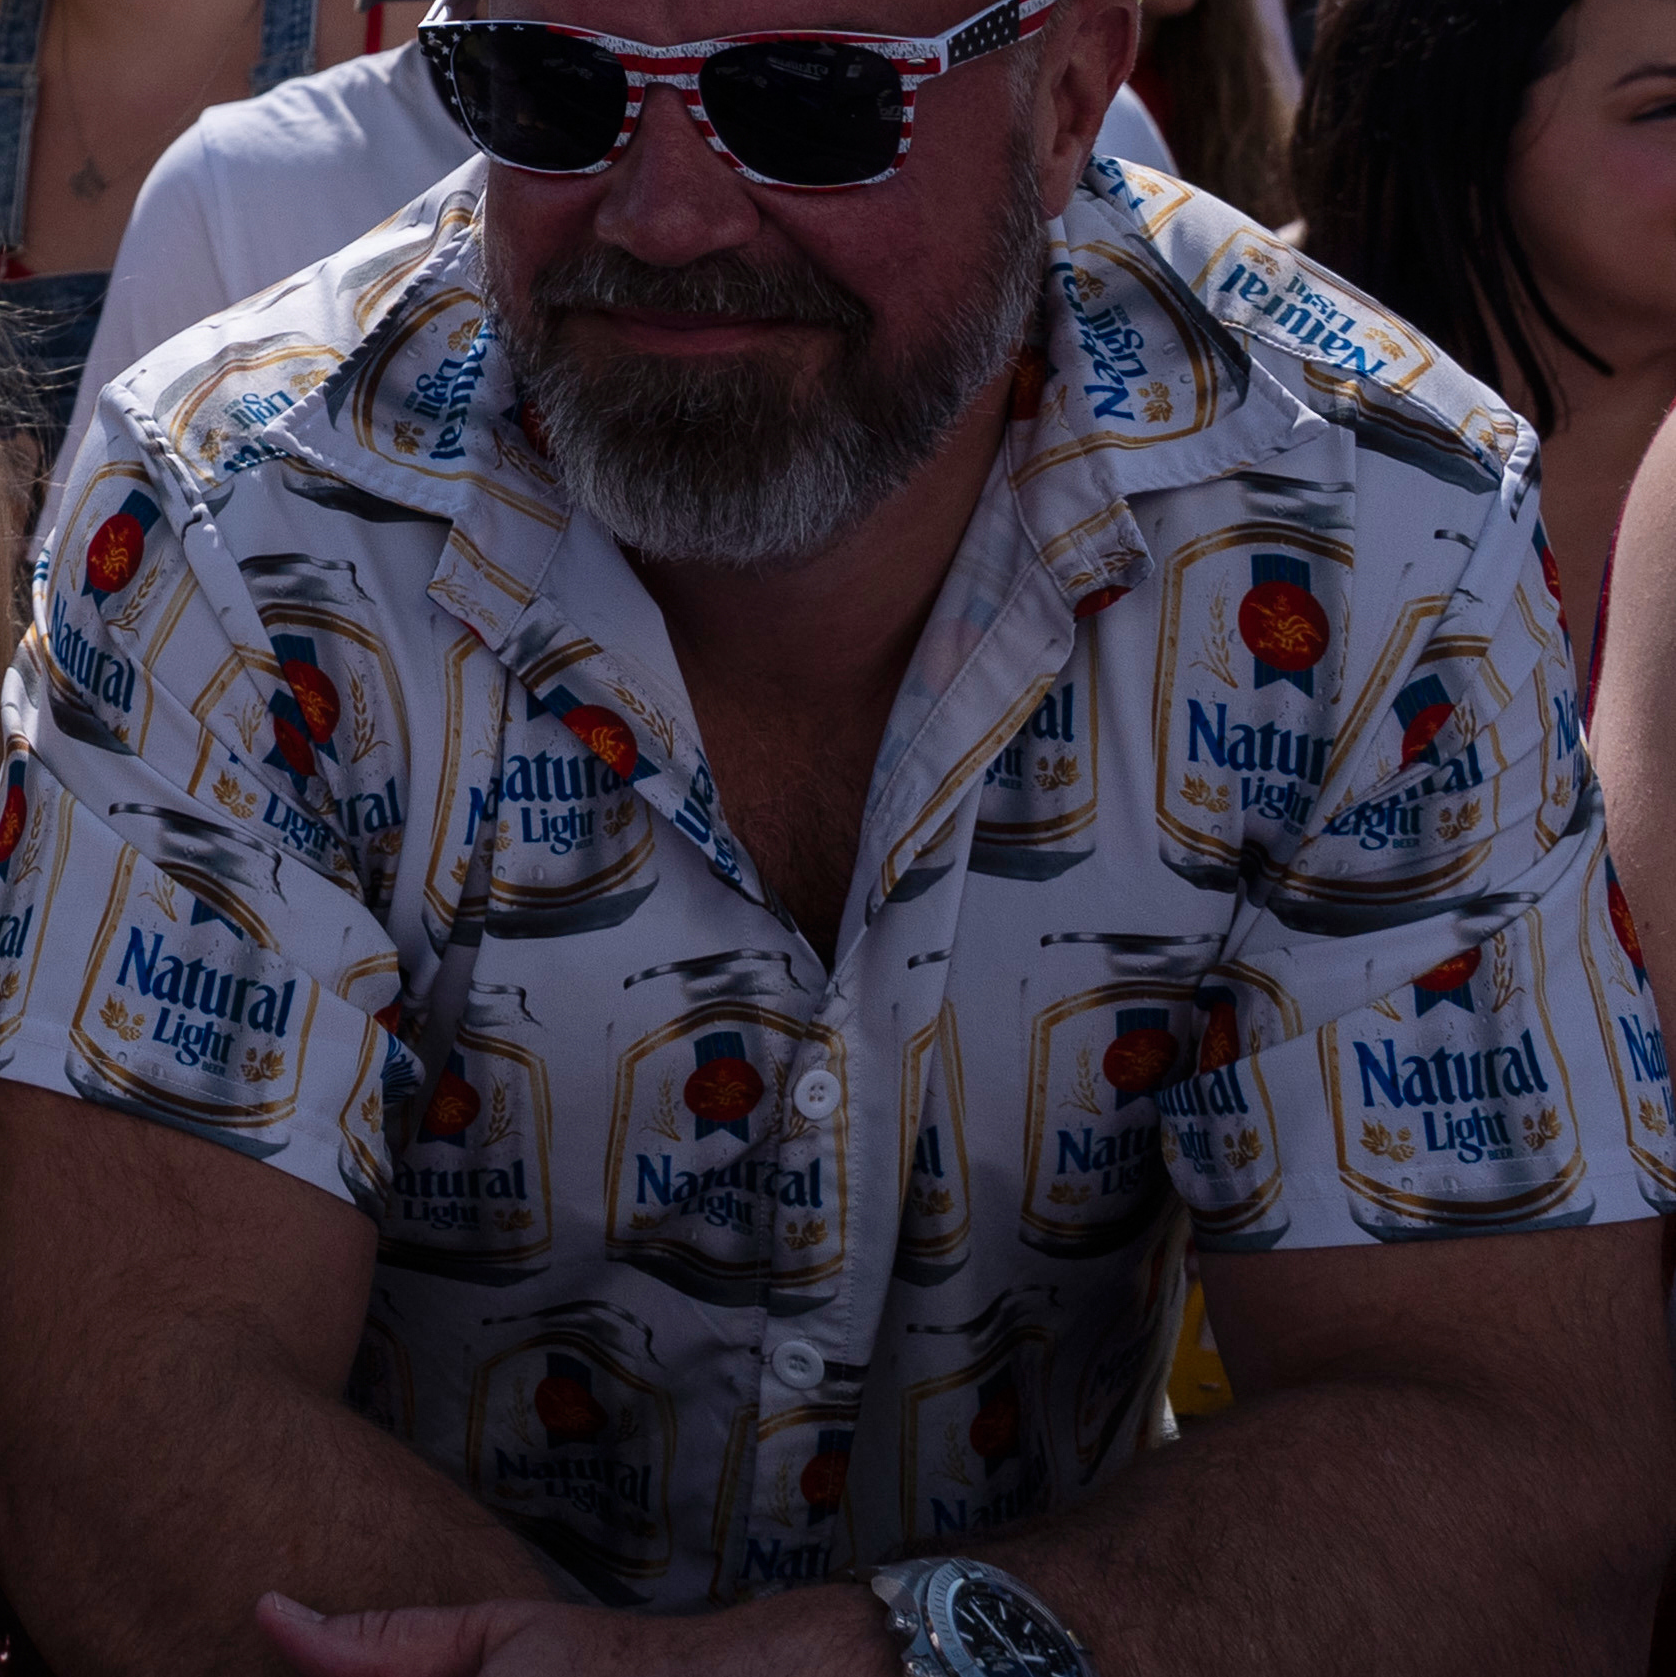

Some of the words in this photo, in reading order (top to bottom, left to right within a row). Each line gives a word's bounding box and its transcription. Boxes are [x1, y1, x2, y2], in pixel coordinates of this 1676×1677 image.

[1219, 264, 1388, 378] Natural
[1284, 273, 1356, 334] Light
[51, 591, 135, 714] Natural
[1241, 776, 1315, 826] Light
[520, 807, 596, 855] Light
[1392, 838, 1421, 850] BEER
[115, 926, 297, 1038] Natural
[151, 1006, 235, 1066] Light
[201, 1060, 227, 1076] BEER
[1352, 1028, 1550, 1110] Natural
[1422, 1108, 1511, 1165] Light
[1487, 1150, 1514, 1163] BEER
[403, 1201, 479, 1231] Light
[495, 1447, 651, 1514] Natural
